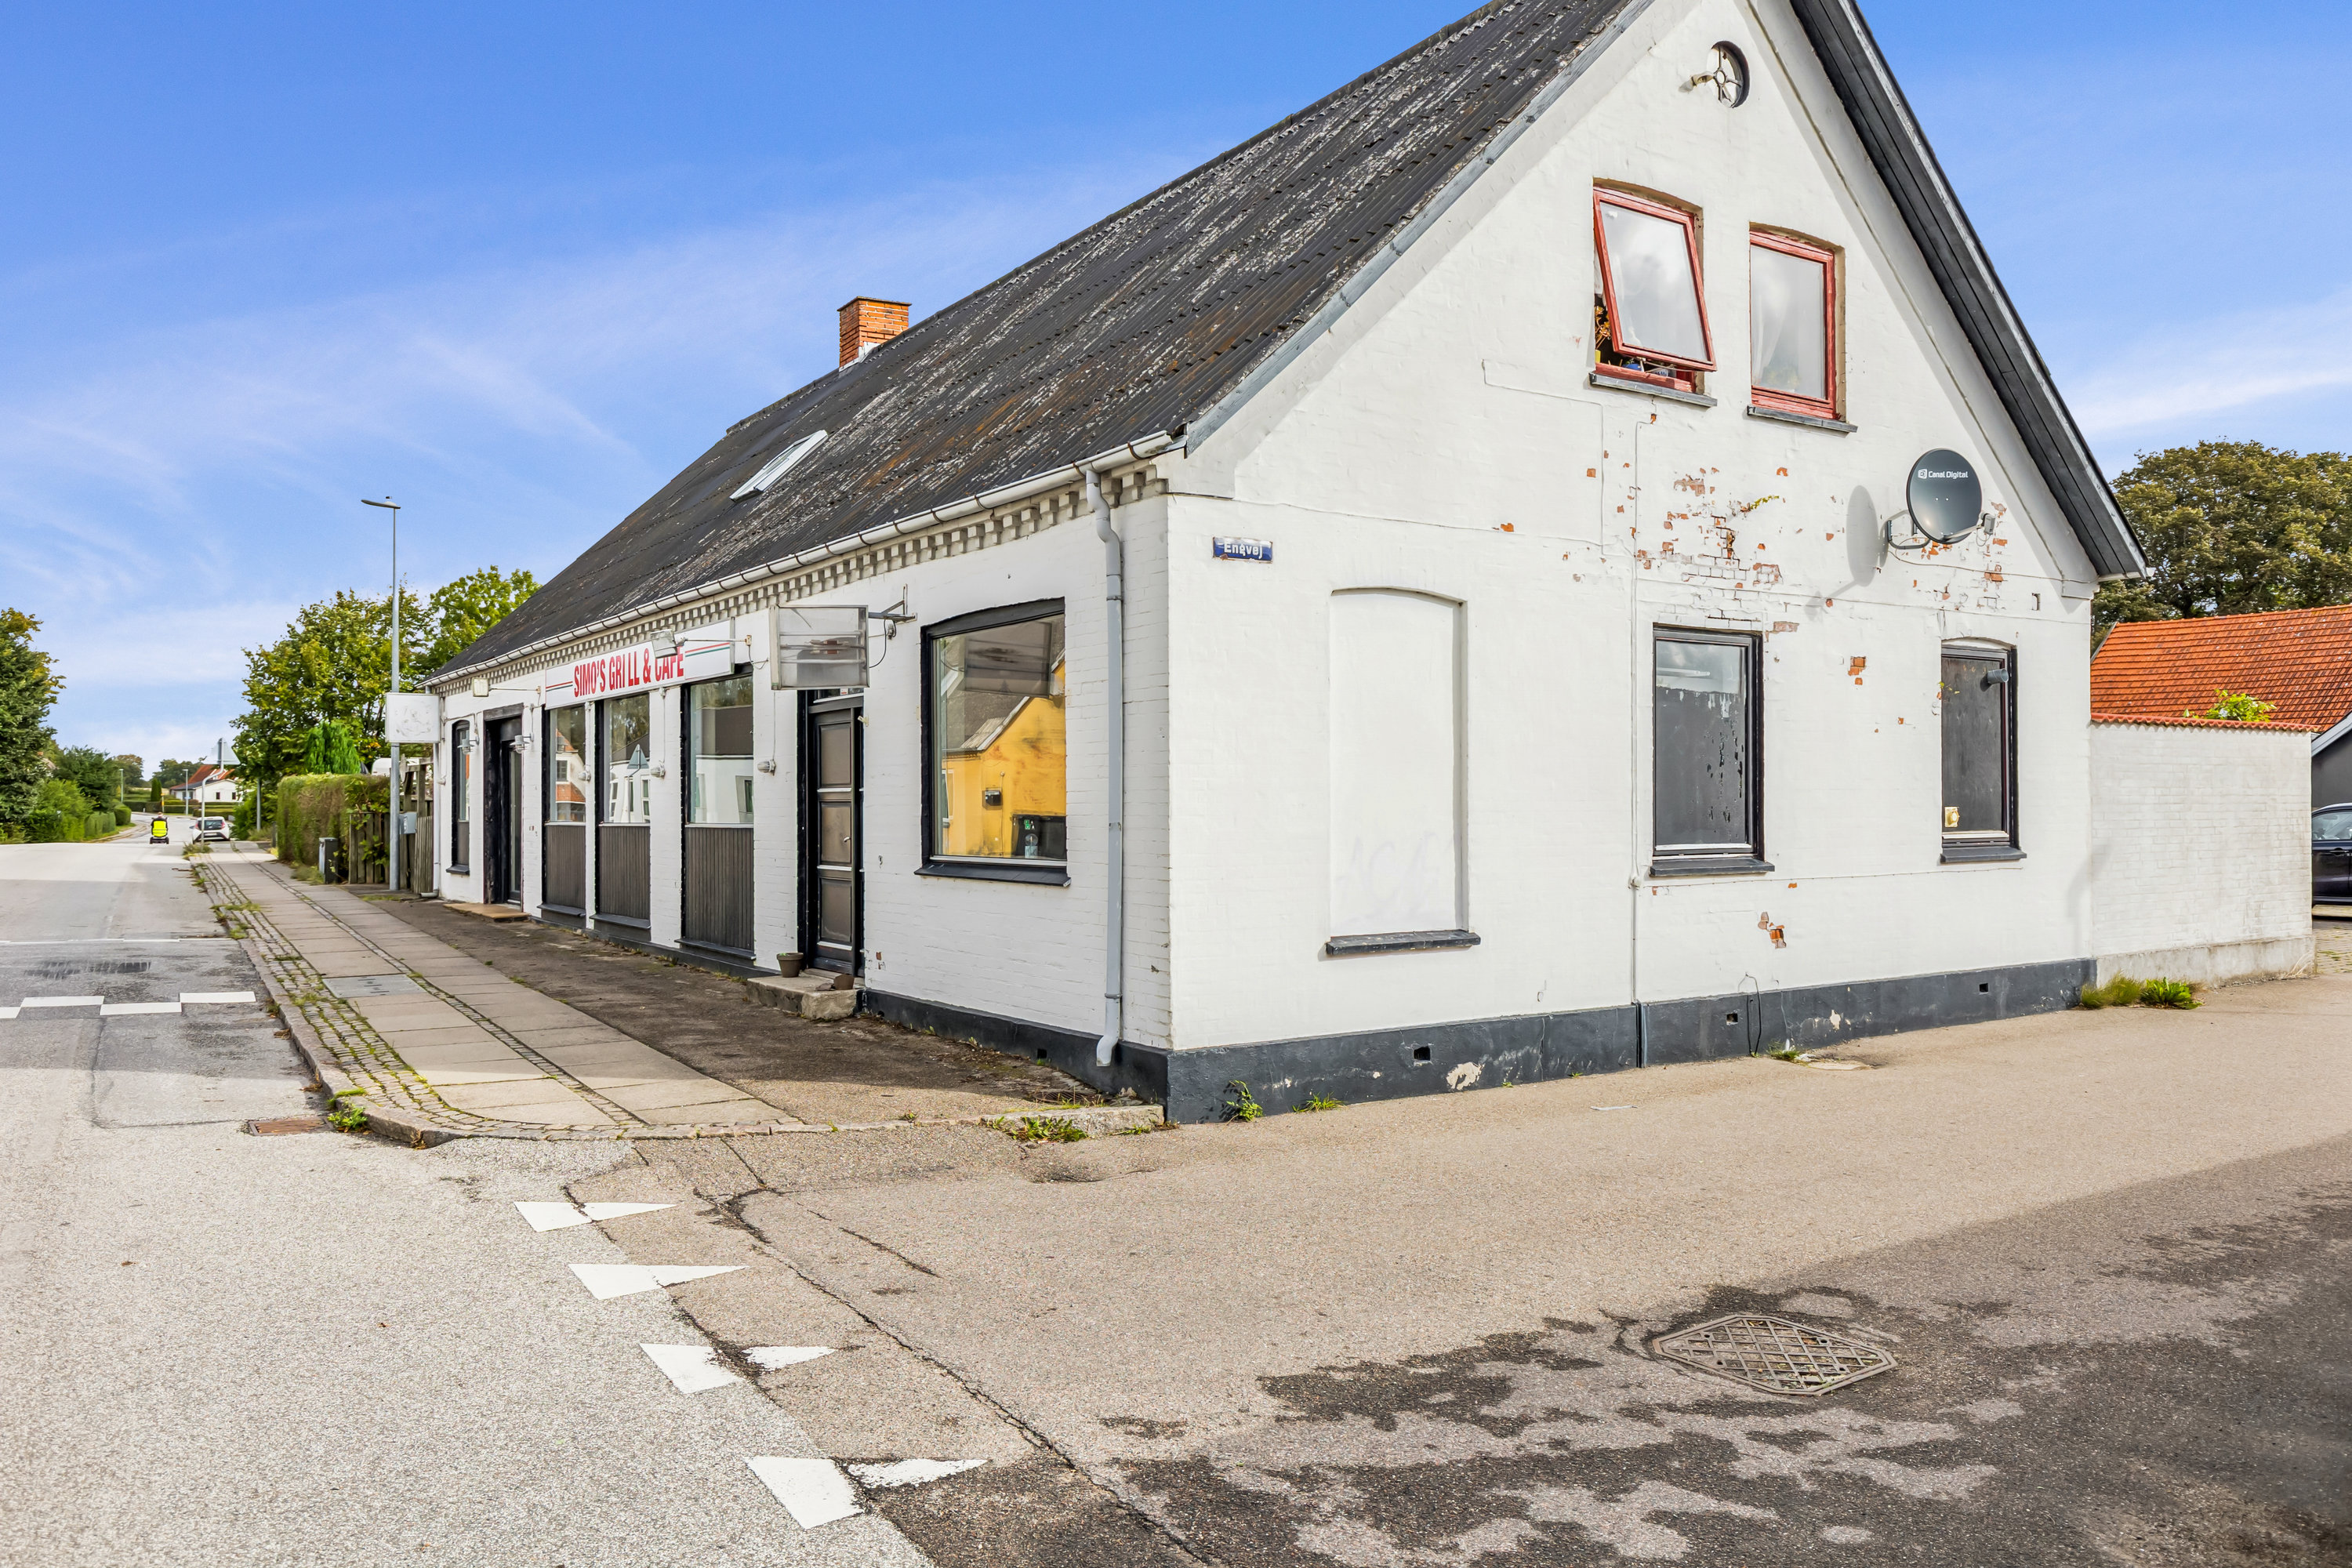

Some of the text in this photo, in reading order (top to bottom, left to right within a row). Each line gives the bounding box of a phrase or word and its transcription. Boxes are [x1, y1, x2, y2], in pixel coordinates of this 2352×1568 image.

[1946, 470, 1969, 480] Digital
[574, 659, 606, 698] SIMO'S
[608, 652, 640, 691] GRILL
[643, 648, 652, 684] &
